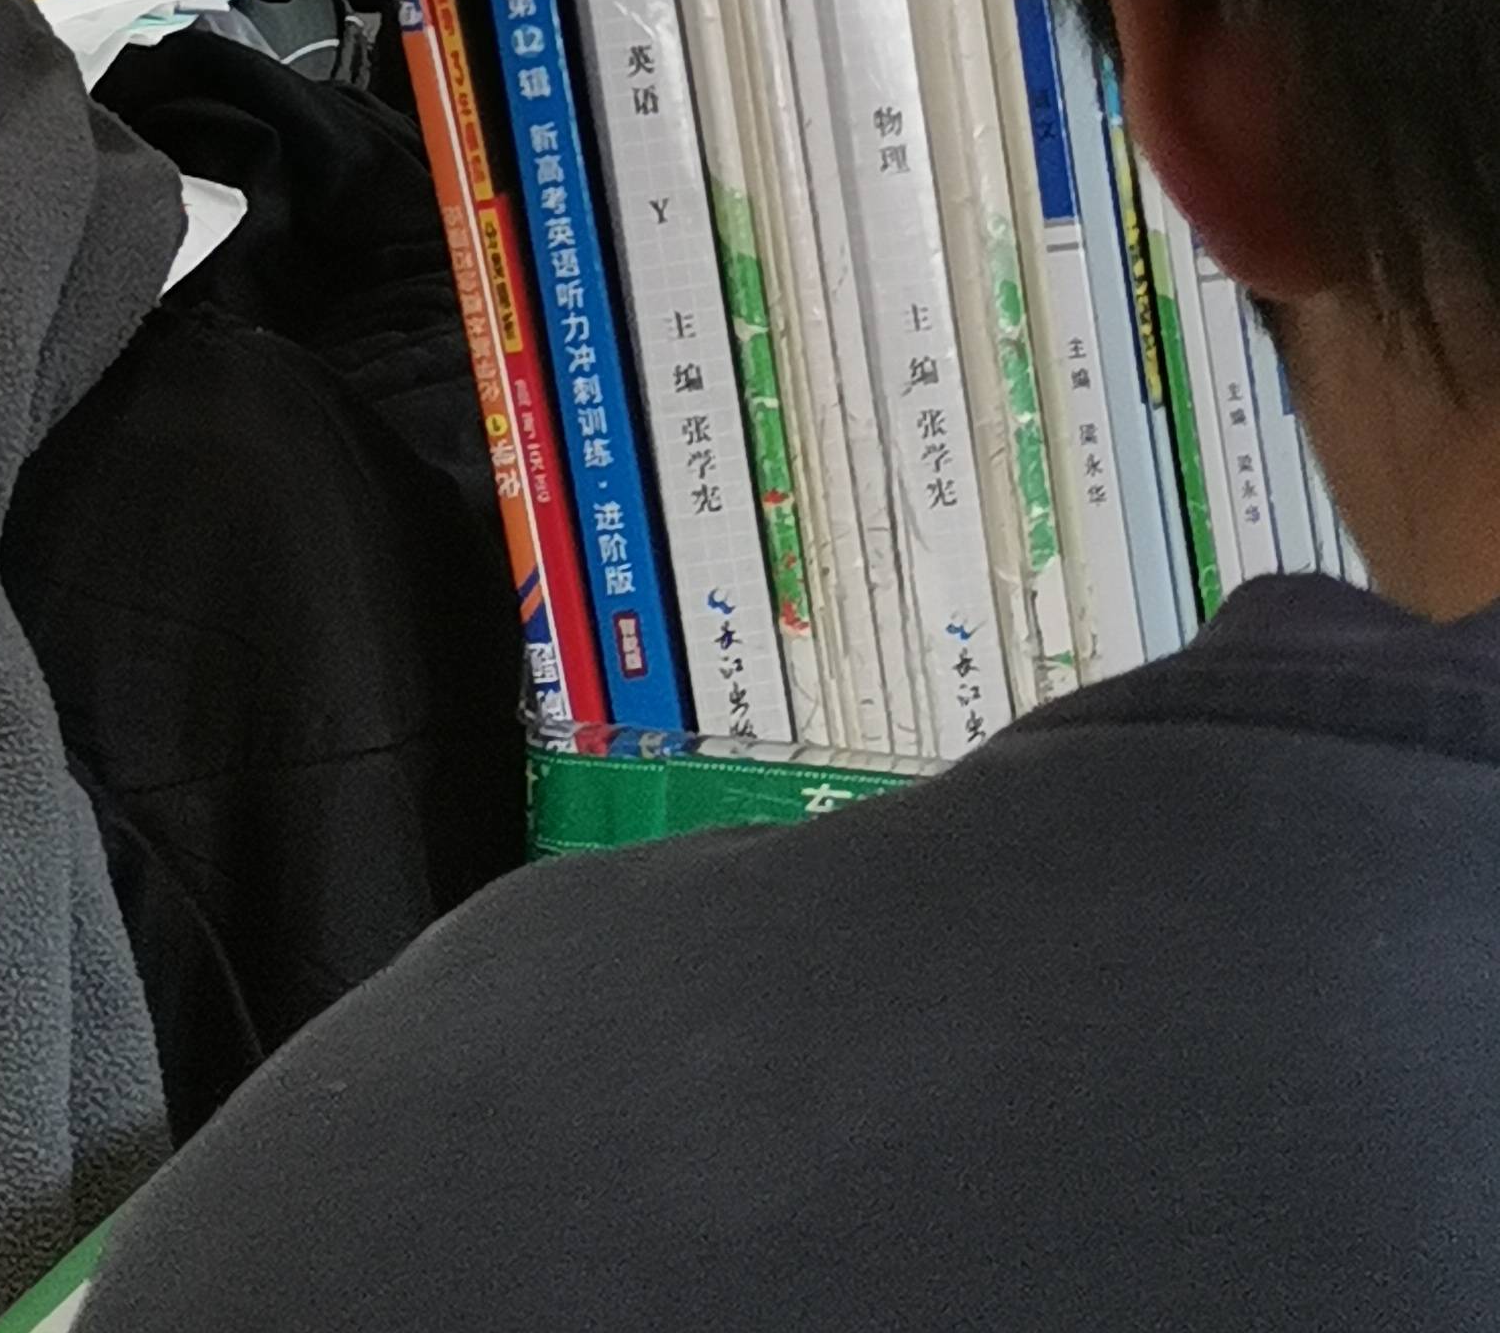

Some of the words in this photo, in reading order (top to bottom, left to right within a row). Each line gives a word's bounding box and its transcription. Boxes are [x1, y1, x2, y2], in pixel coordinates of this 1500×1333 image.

[626, 43, 662, 117] 英语
[872, 105, 912, 175] 物理
[665, 311, 704, 394] 主编
[904, 303, 940, 397] 主编
